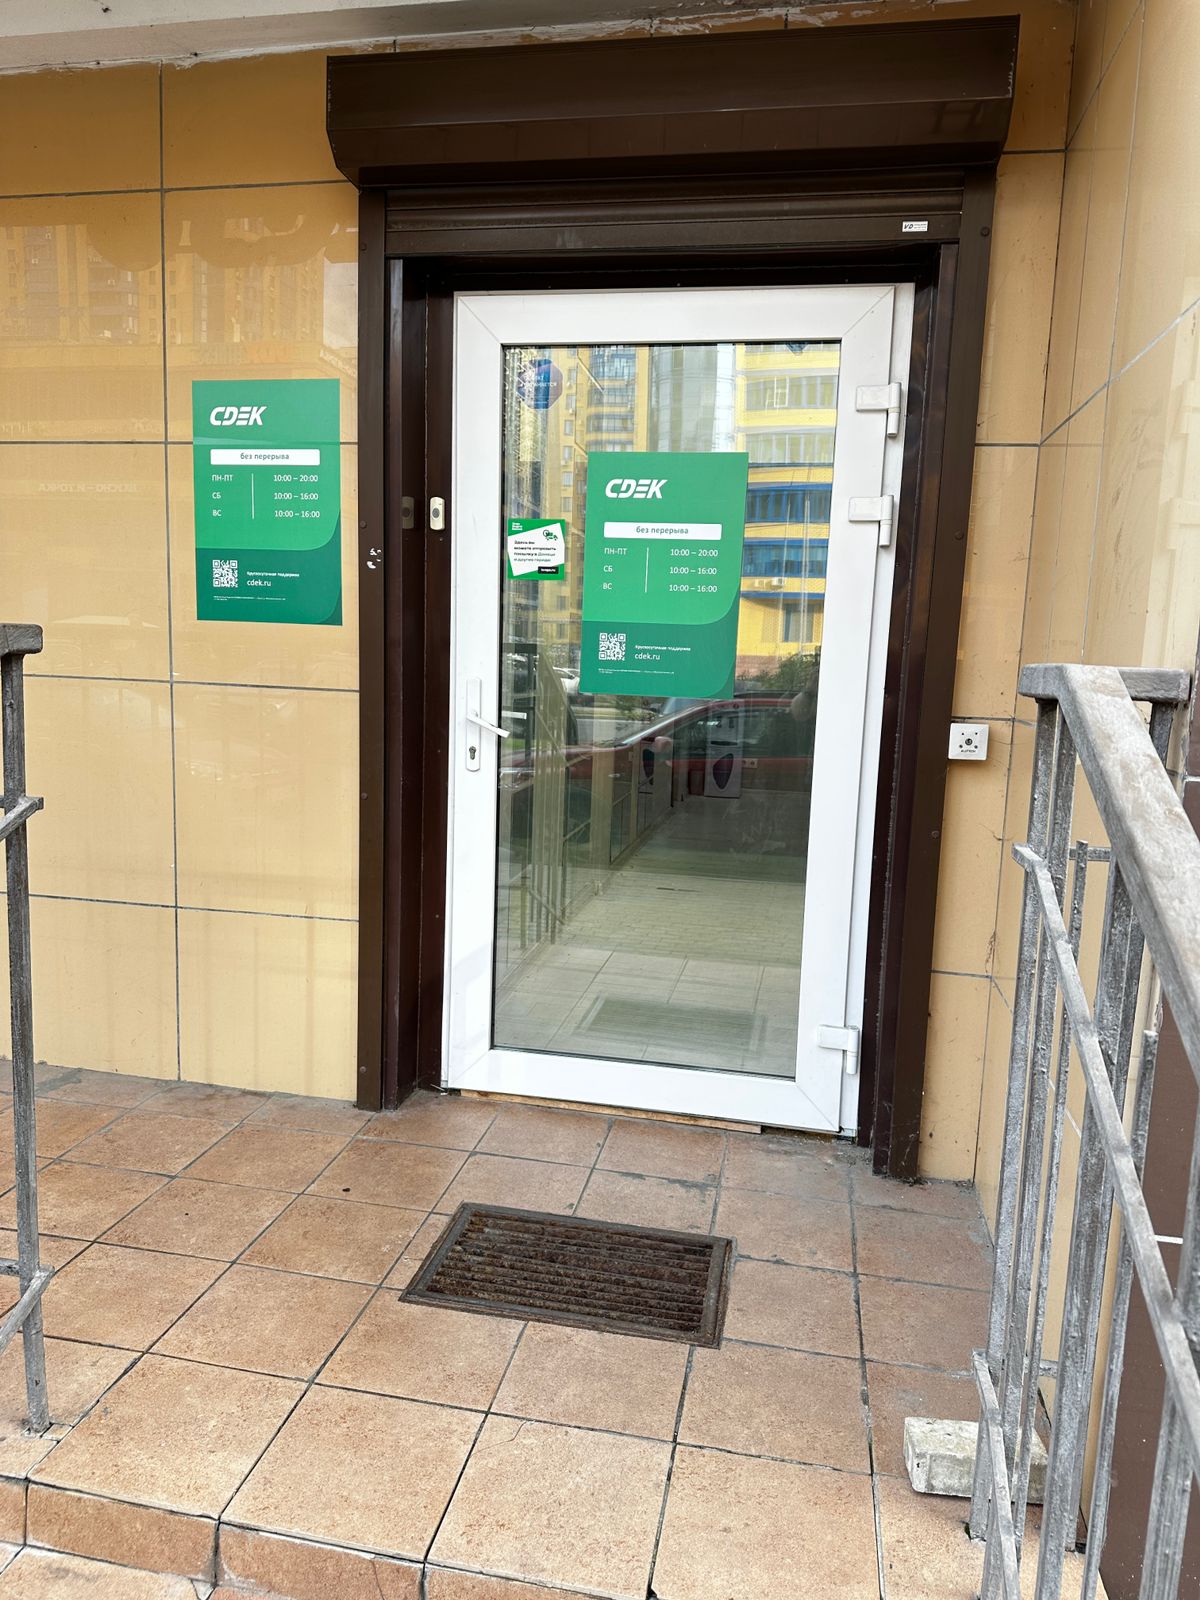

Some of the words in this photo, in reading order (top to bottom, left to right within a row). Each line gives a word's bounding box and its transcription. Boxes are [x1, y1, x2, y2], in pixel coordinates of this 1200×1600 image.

[209, 406, 267, 426] CDEK
[240, 452, 253, 461] без
[211, 474, 234, 483] ПН-ПТ
[273, 474, 292, 483] 10:00
[299, 474, 319, 483] 20:00
[605, 479, 668, 498] CDEK
[211, 491, 222, 500] СБ
[273, 492, 292, 501] 10:00
[300, 492, 319, 501] 16:00
[212, 509, 222, 518] ВС
[274, 510, 294, 518] 10:00
[301, 510, 321, 519] 16:00
[635, 525, 649, 534] без
[651, 528, 689, 536] перерыва
[604, 547, 628, 556] ПН-ПТ
[670, 549, 690, 557] 10:00
[697, 549, 719, 557] 20:00
[603, 565, 613, 573] СБ
[669, 567, 689, 575] 10:00
[697, 567, 718, 576] 16:00
[246, 579, 272, 587] cdek.ru
[602, 583, 613, 591] ВС
[669, 584, 689, 592] 10:00
[697, 585, 718, 593] 16:00
[634, 652, 661, 660] cdek.ru
